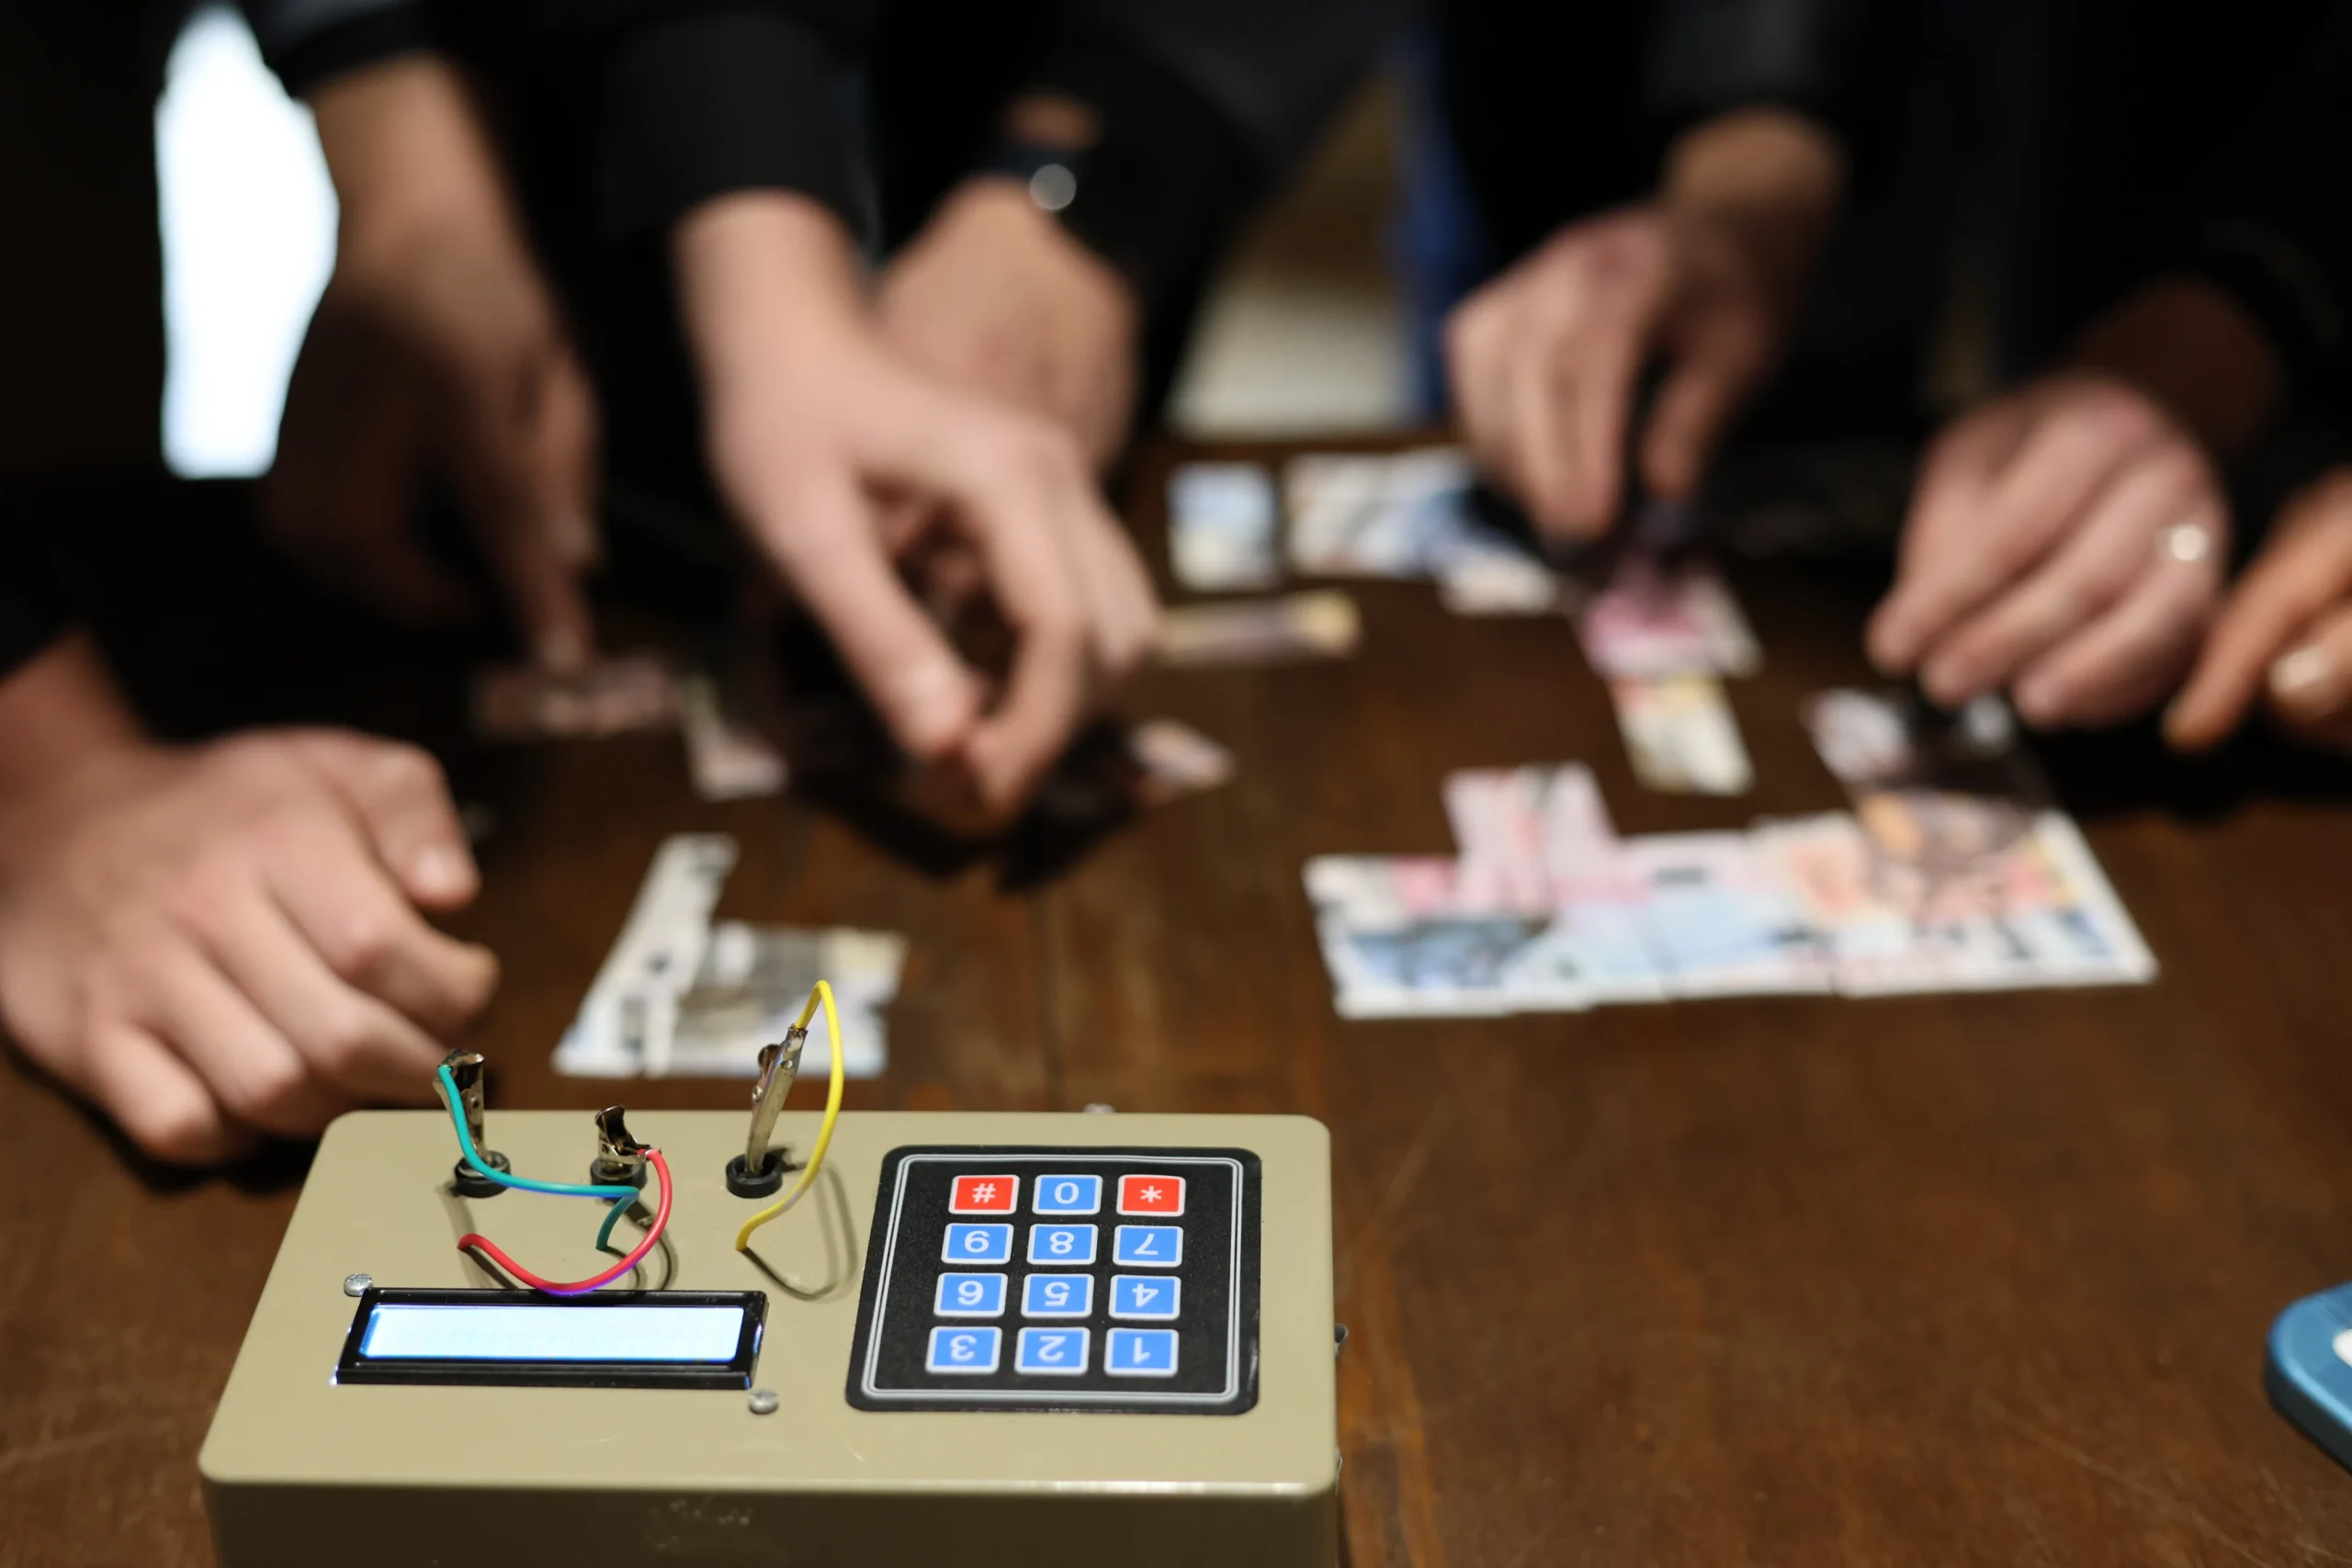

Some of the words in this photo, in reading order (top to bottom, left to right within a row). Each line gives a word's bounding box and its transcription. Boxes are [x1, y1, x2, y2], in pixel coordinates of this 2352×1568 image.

[972, 1182, 997, 1203] #
[1054, 1181, 1080, 1204] 0
[964, 1230, 990, 1254] 9
[1049, 1231, 1075, 1255] 8
[1133, 1233, 1159, 1256] 7
[957, 1280, 984, 1306] 6
[1044, 1281, 1070, 1307] 5
[1132, 1282, 1159, 1308] 4
[950, 1335, 978, 1361] 3
[1037, 1335, 1066, 1362] 2
[1133, 1337, 1151, 1364] 1
